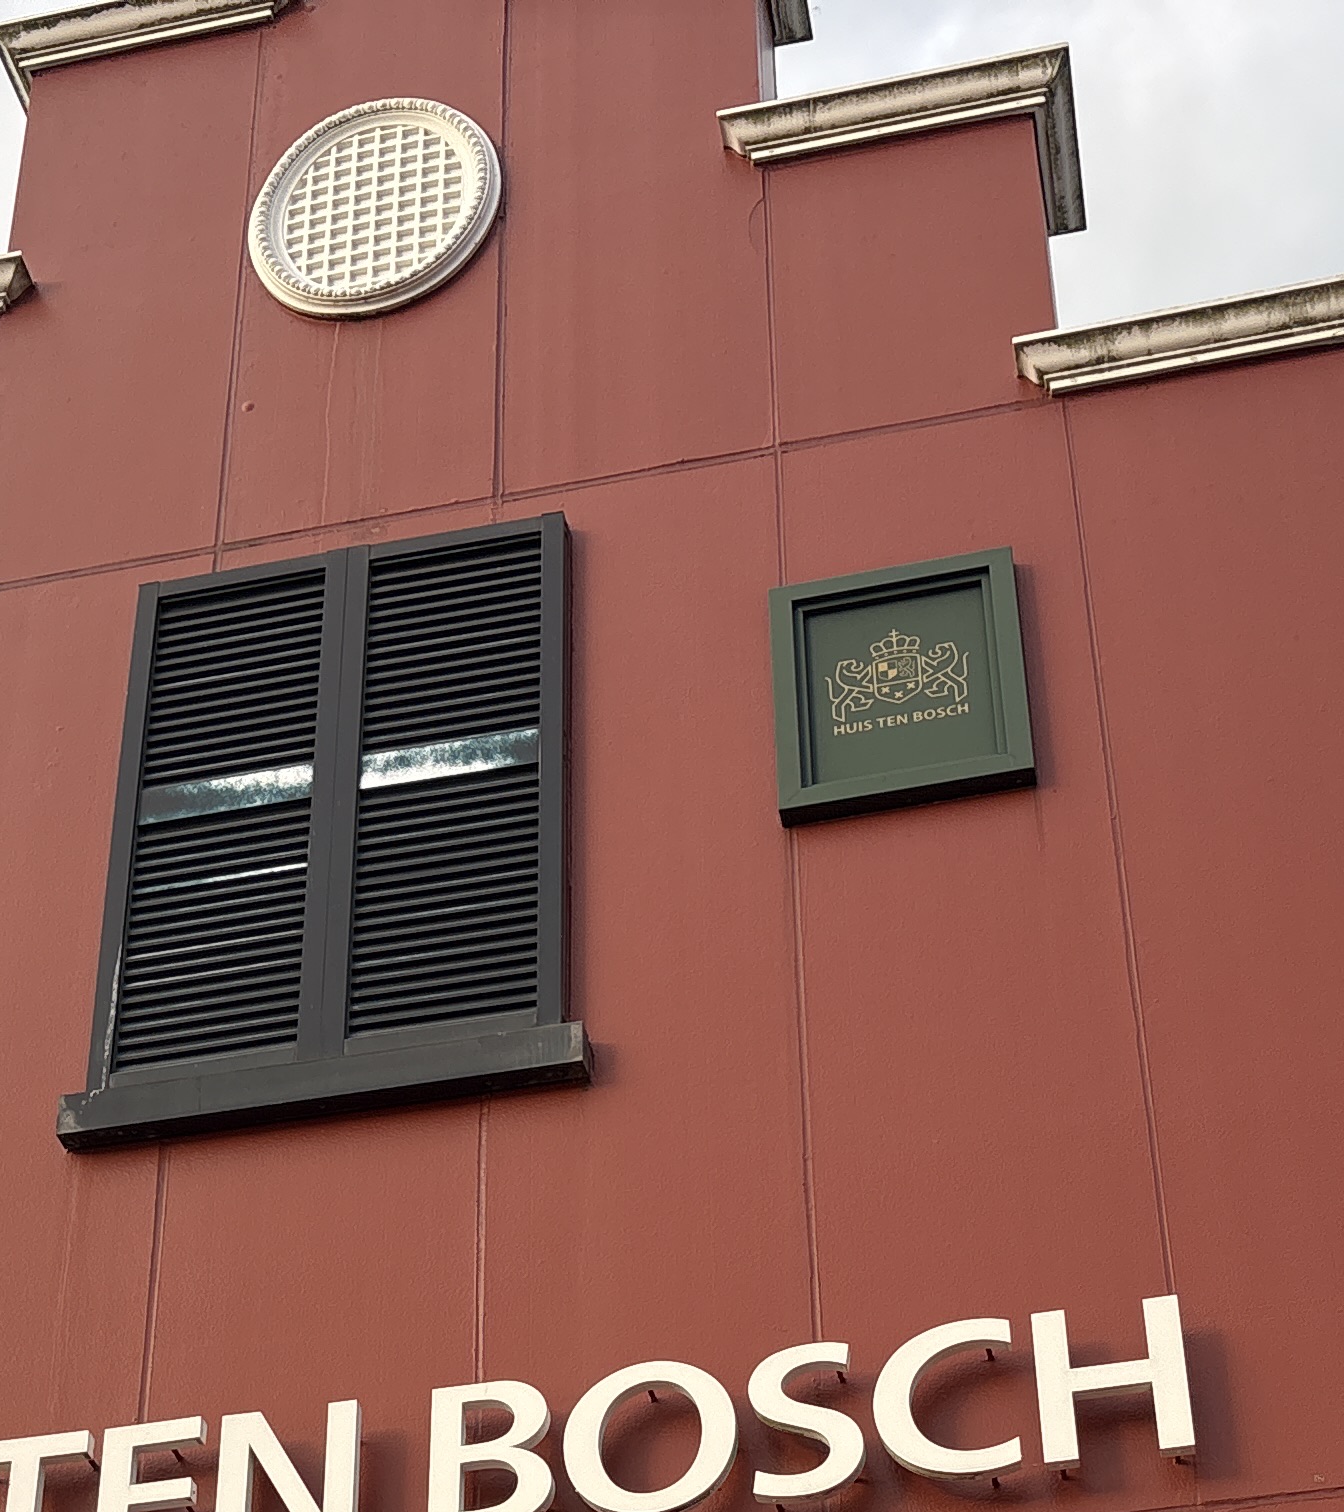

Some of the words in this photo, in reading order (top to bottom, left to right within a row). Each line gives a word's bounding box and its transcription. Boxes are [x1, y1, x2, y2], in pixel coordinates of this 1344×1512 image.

[833, 720, 873, 736] HUIS
[876, 713, 908, 728] TEN
[912, 703, 969, 722] BOSCH
